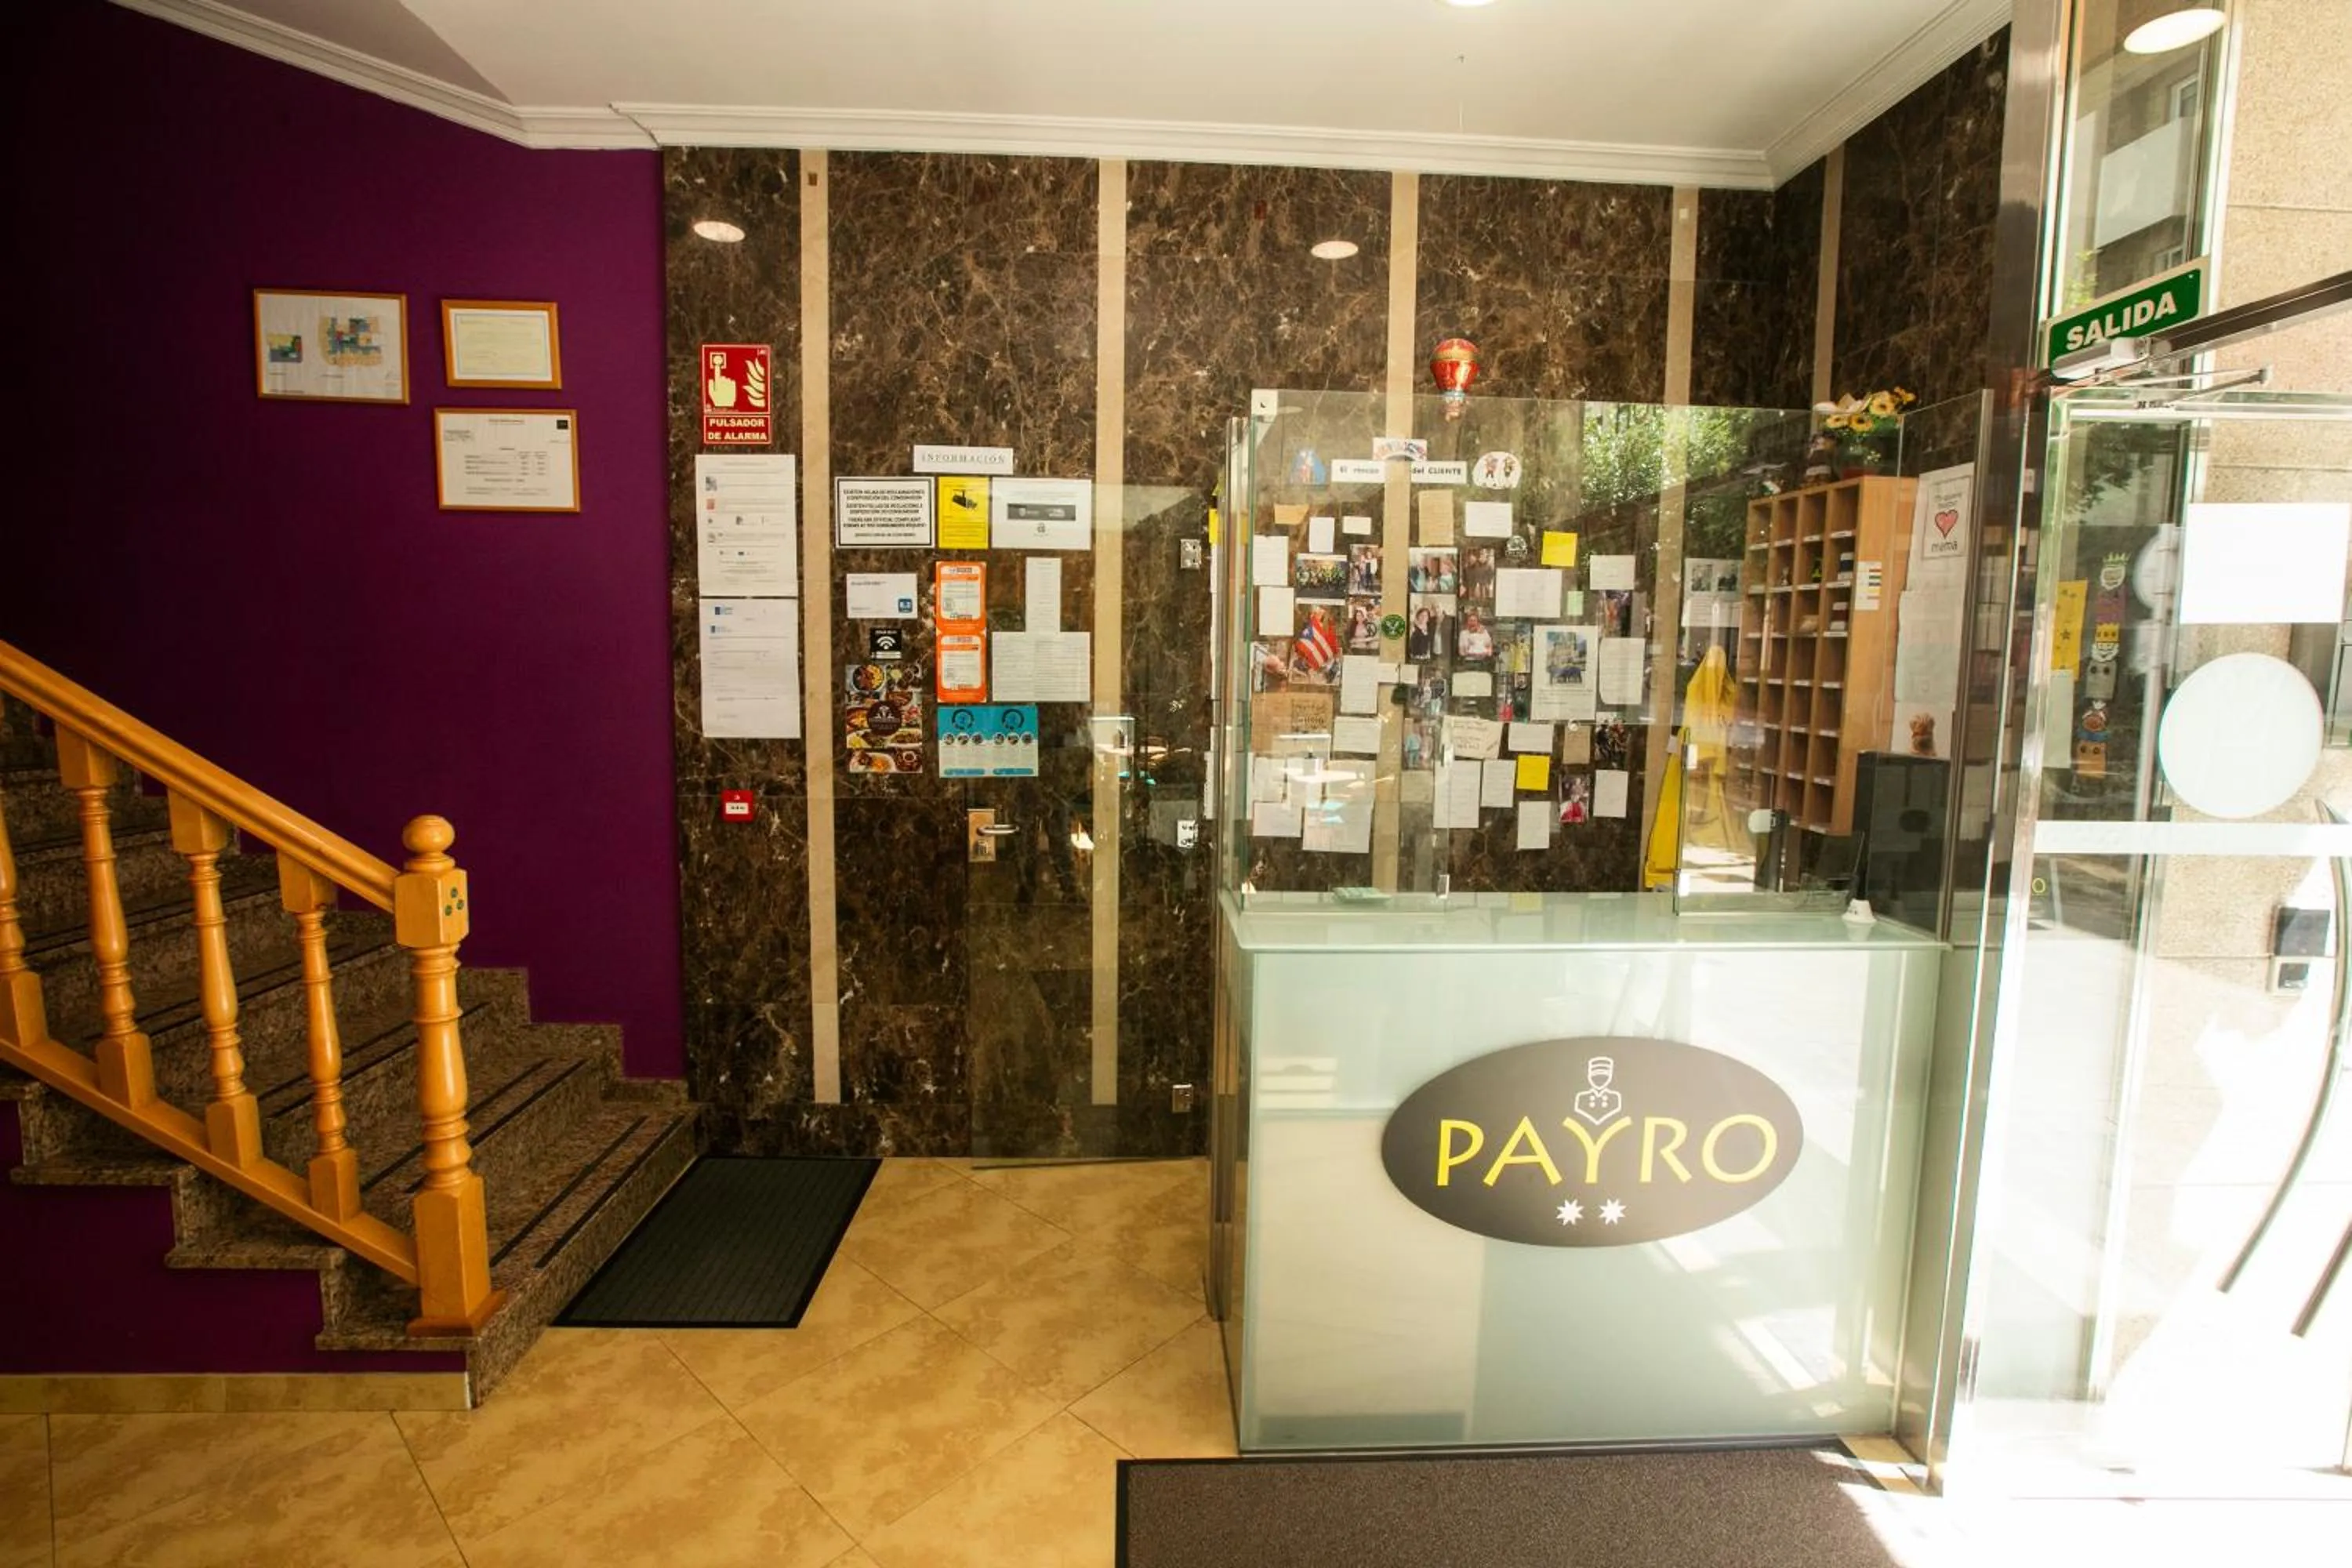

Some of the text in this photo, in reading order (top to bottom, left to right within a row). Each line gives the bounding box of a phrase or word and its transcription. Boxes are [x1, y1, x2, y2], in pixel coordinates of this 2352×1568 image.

[2065, 291, 2177, 350] SALIDA
[709, 418, 765, 427] PULSADOR
[1436, 1113, 1778, 1186] PAYRO
